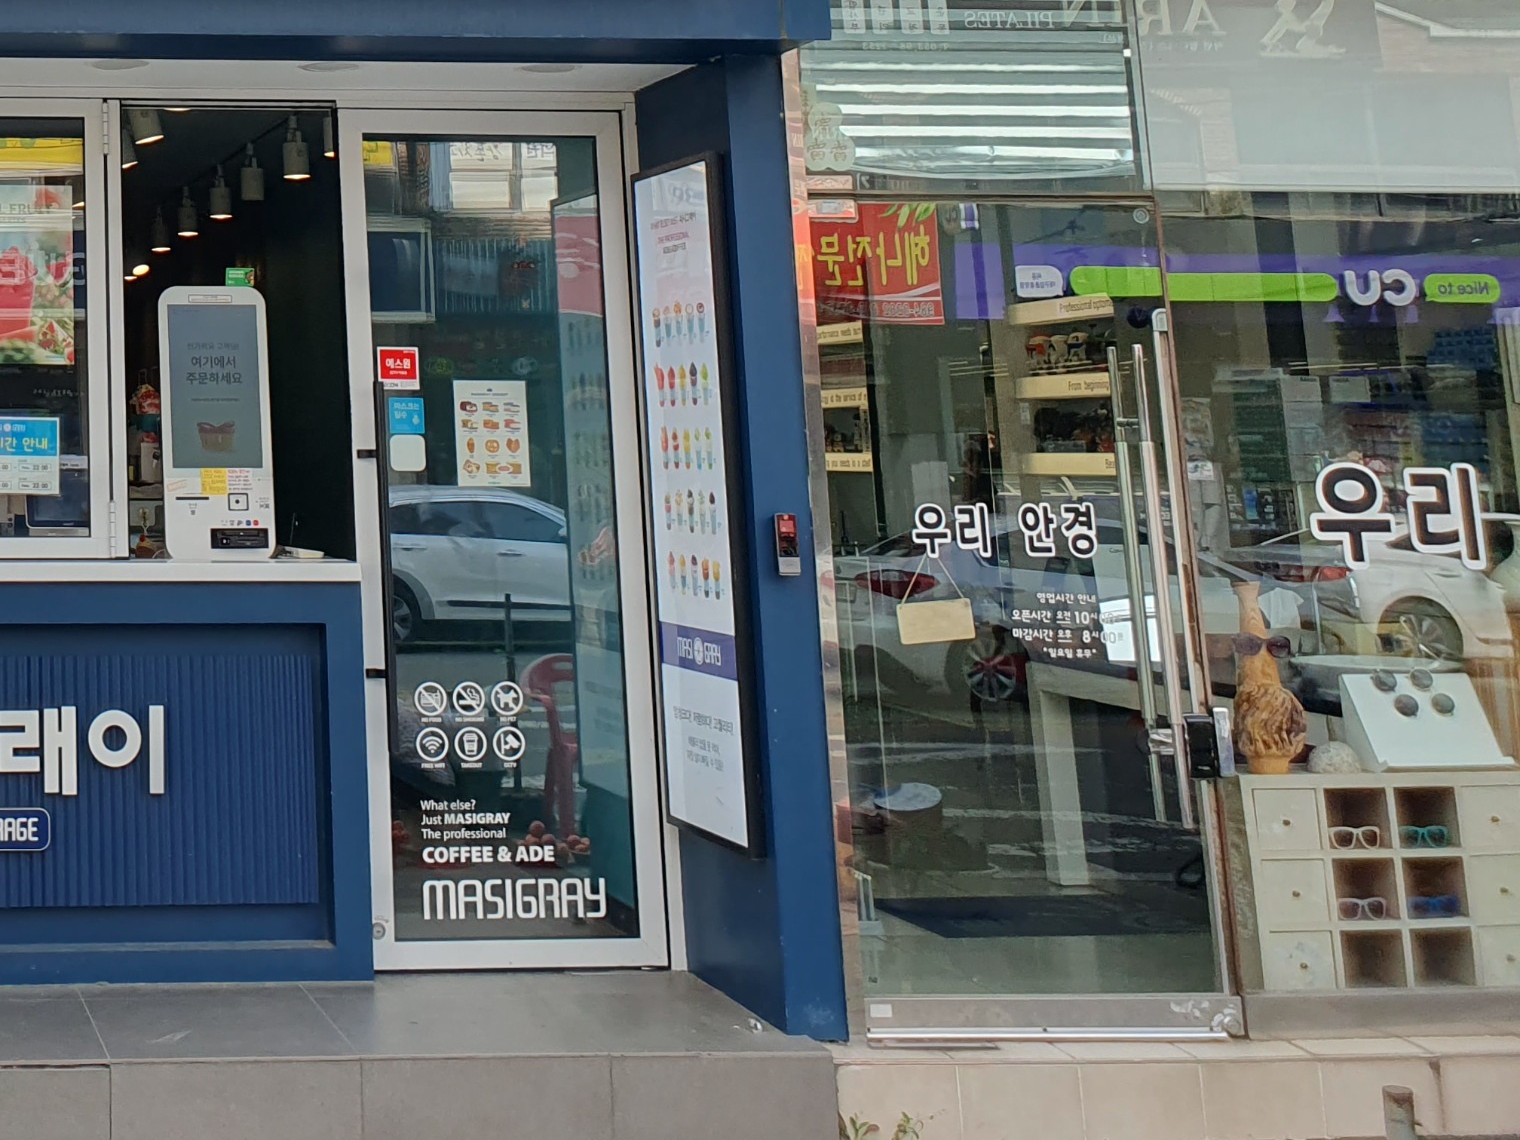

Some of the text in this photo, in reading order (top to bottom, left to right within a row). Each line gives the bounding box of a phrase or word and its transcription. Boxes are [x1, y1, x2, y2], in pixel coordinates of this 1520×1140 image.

[22, 437, 48, 451] 안내
[1310, 461, 1488, 570] 우리
[912, 502, 1098, 558] 우리 안경
[1036, 592, 1097, 604] 영업시간 안내
[1011, 609, 1052, 623] 오픈시간
[1012, 628, 1053, 642] 마감시간
[420, 799, 448, 811] What
[421, 812, 511, 826] Just MASIGRAY
[421, 828, 507, 842] The professional
[422, 845, 556, 864] COFFEE & ADE
[422, 876, 608, 921] MASIGRAY
